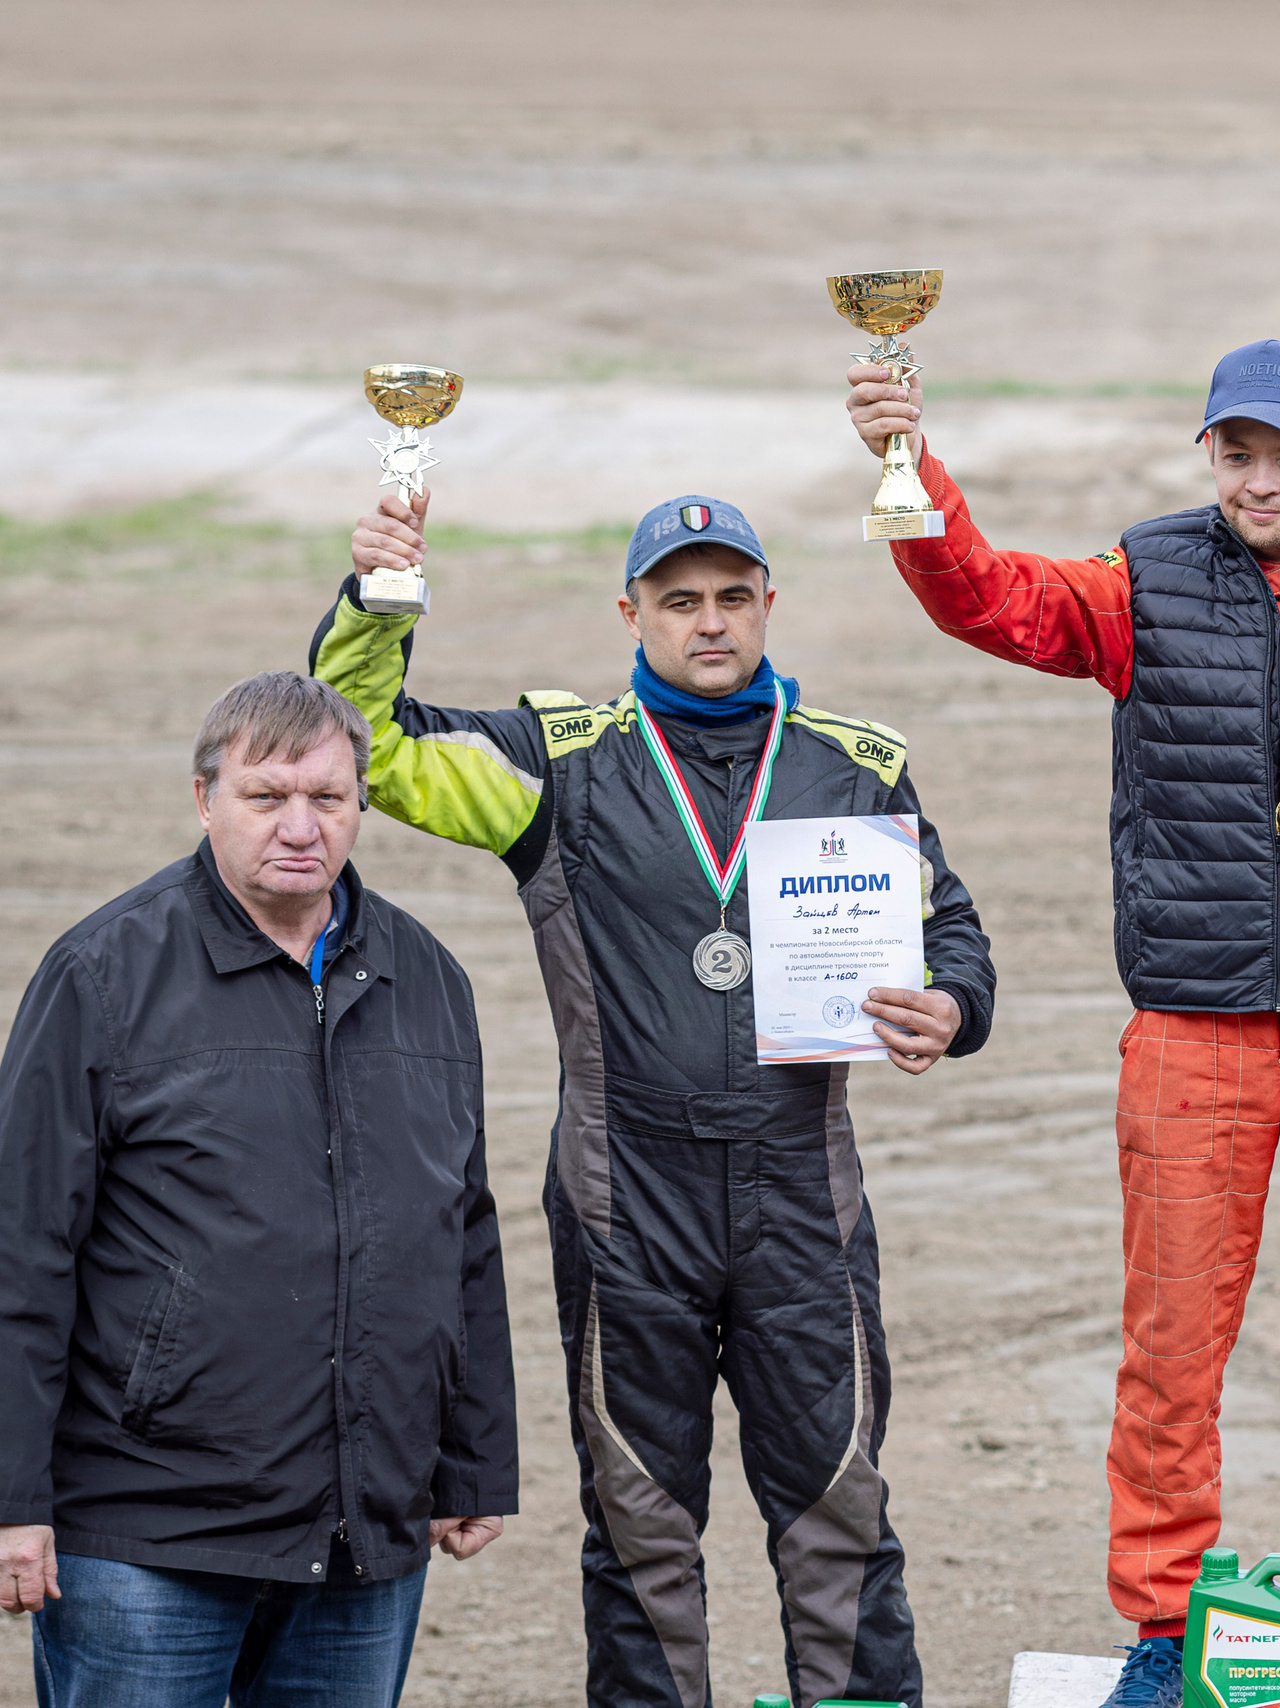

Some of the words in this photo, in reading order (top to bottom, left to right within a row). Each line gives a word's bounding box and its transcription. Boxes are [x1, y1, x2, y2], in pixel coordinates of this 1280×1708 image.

[550, 719, 592, 738] OMP
[856, 740, 894, 763] OMP
[779, 873, 891, 898] ДИПЛОМ
[793, 903, 839, 918] Зайцев
[847, 902, 880, 920] Артем
[824, 926, 830, 934] 2
[832, 926, 859, 934] место
[819, 939, 873, 947] Новосибирской
[711, 949, 733, 973] 2
[799, 951, 859, 959] автомобильному
[834, 962, 868, 970] трековые
